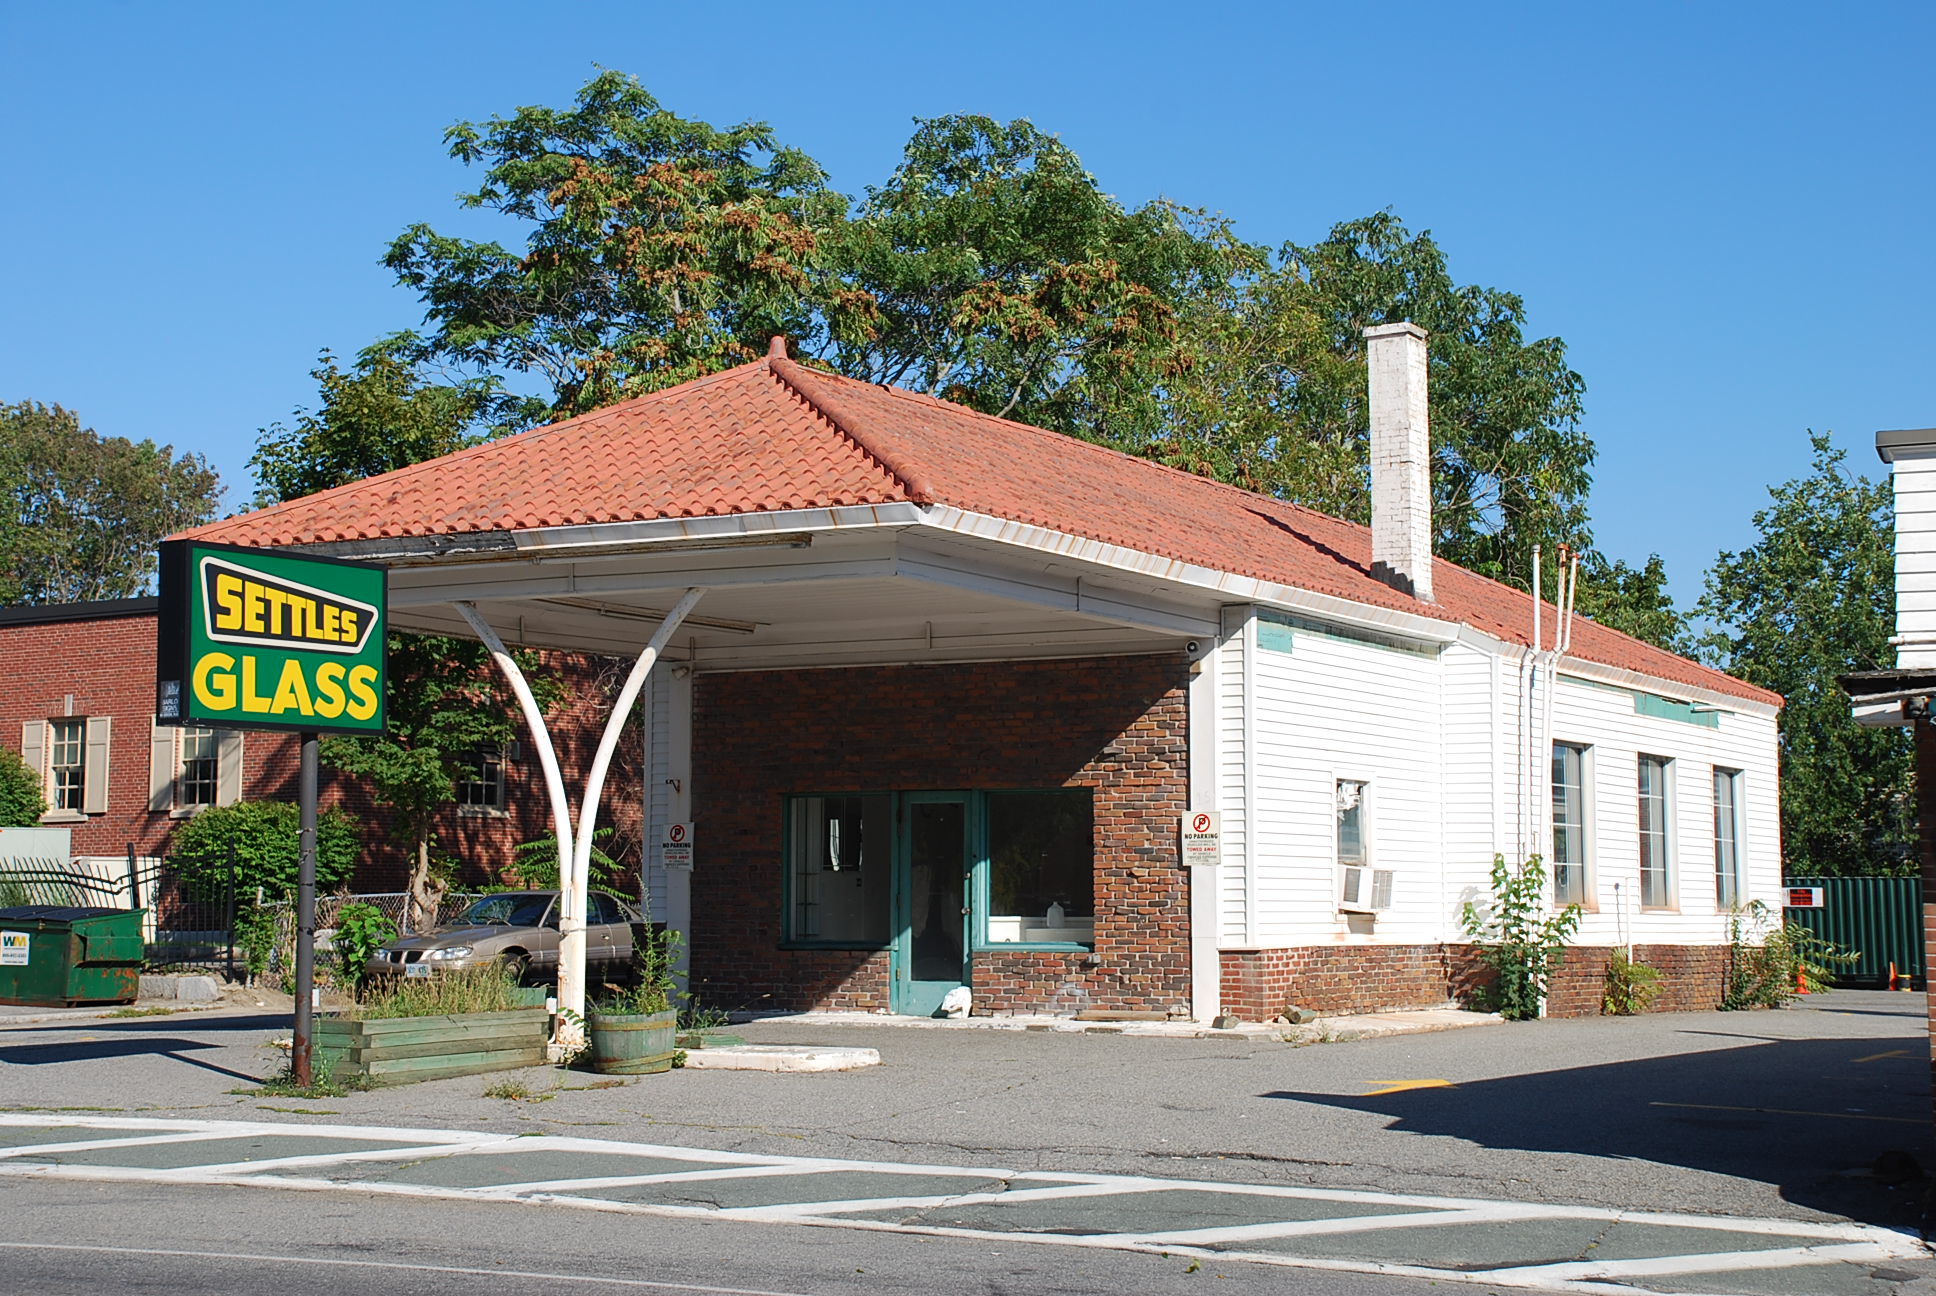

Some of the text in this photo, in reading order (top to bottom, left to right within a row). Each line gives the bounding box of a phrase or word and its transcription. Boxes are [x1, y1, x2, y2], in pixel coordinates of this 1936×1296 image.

[216, 573, 358, 643] SETTLES
[192, 652, 379, 721] GLASS
[3, 936, 27, 947] WM
